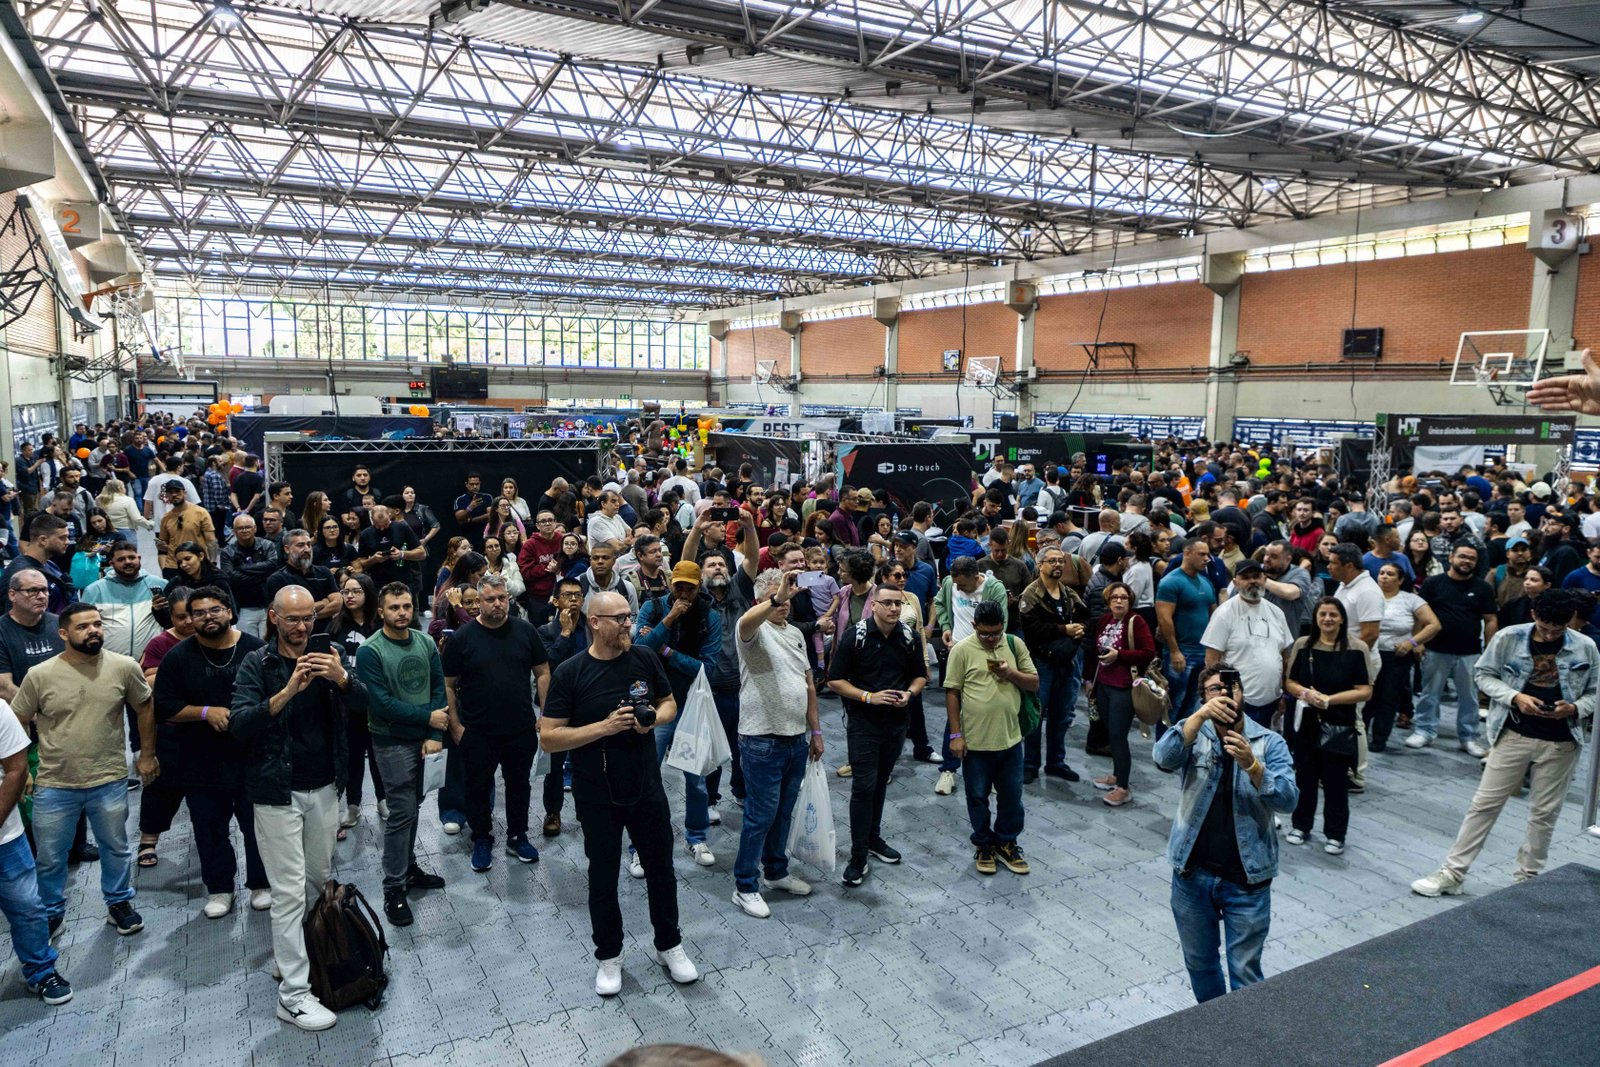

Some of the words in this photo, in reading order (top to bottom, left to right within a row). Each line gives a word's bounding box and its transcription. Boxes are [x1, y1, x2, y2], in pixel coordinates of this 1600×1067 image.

[62, 209, 81, 234] 2
[1551, 219, 1567, 245] 3
[1015, 286, 1025, 303] 2
[1018, 447, 1042, 455] Bambu
[897, 464, 907, 472] 3D
[915, 463, 940, 472] touch
